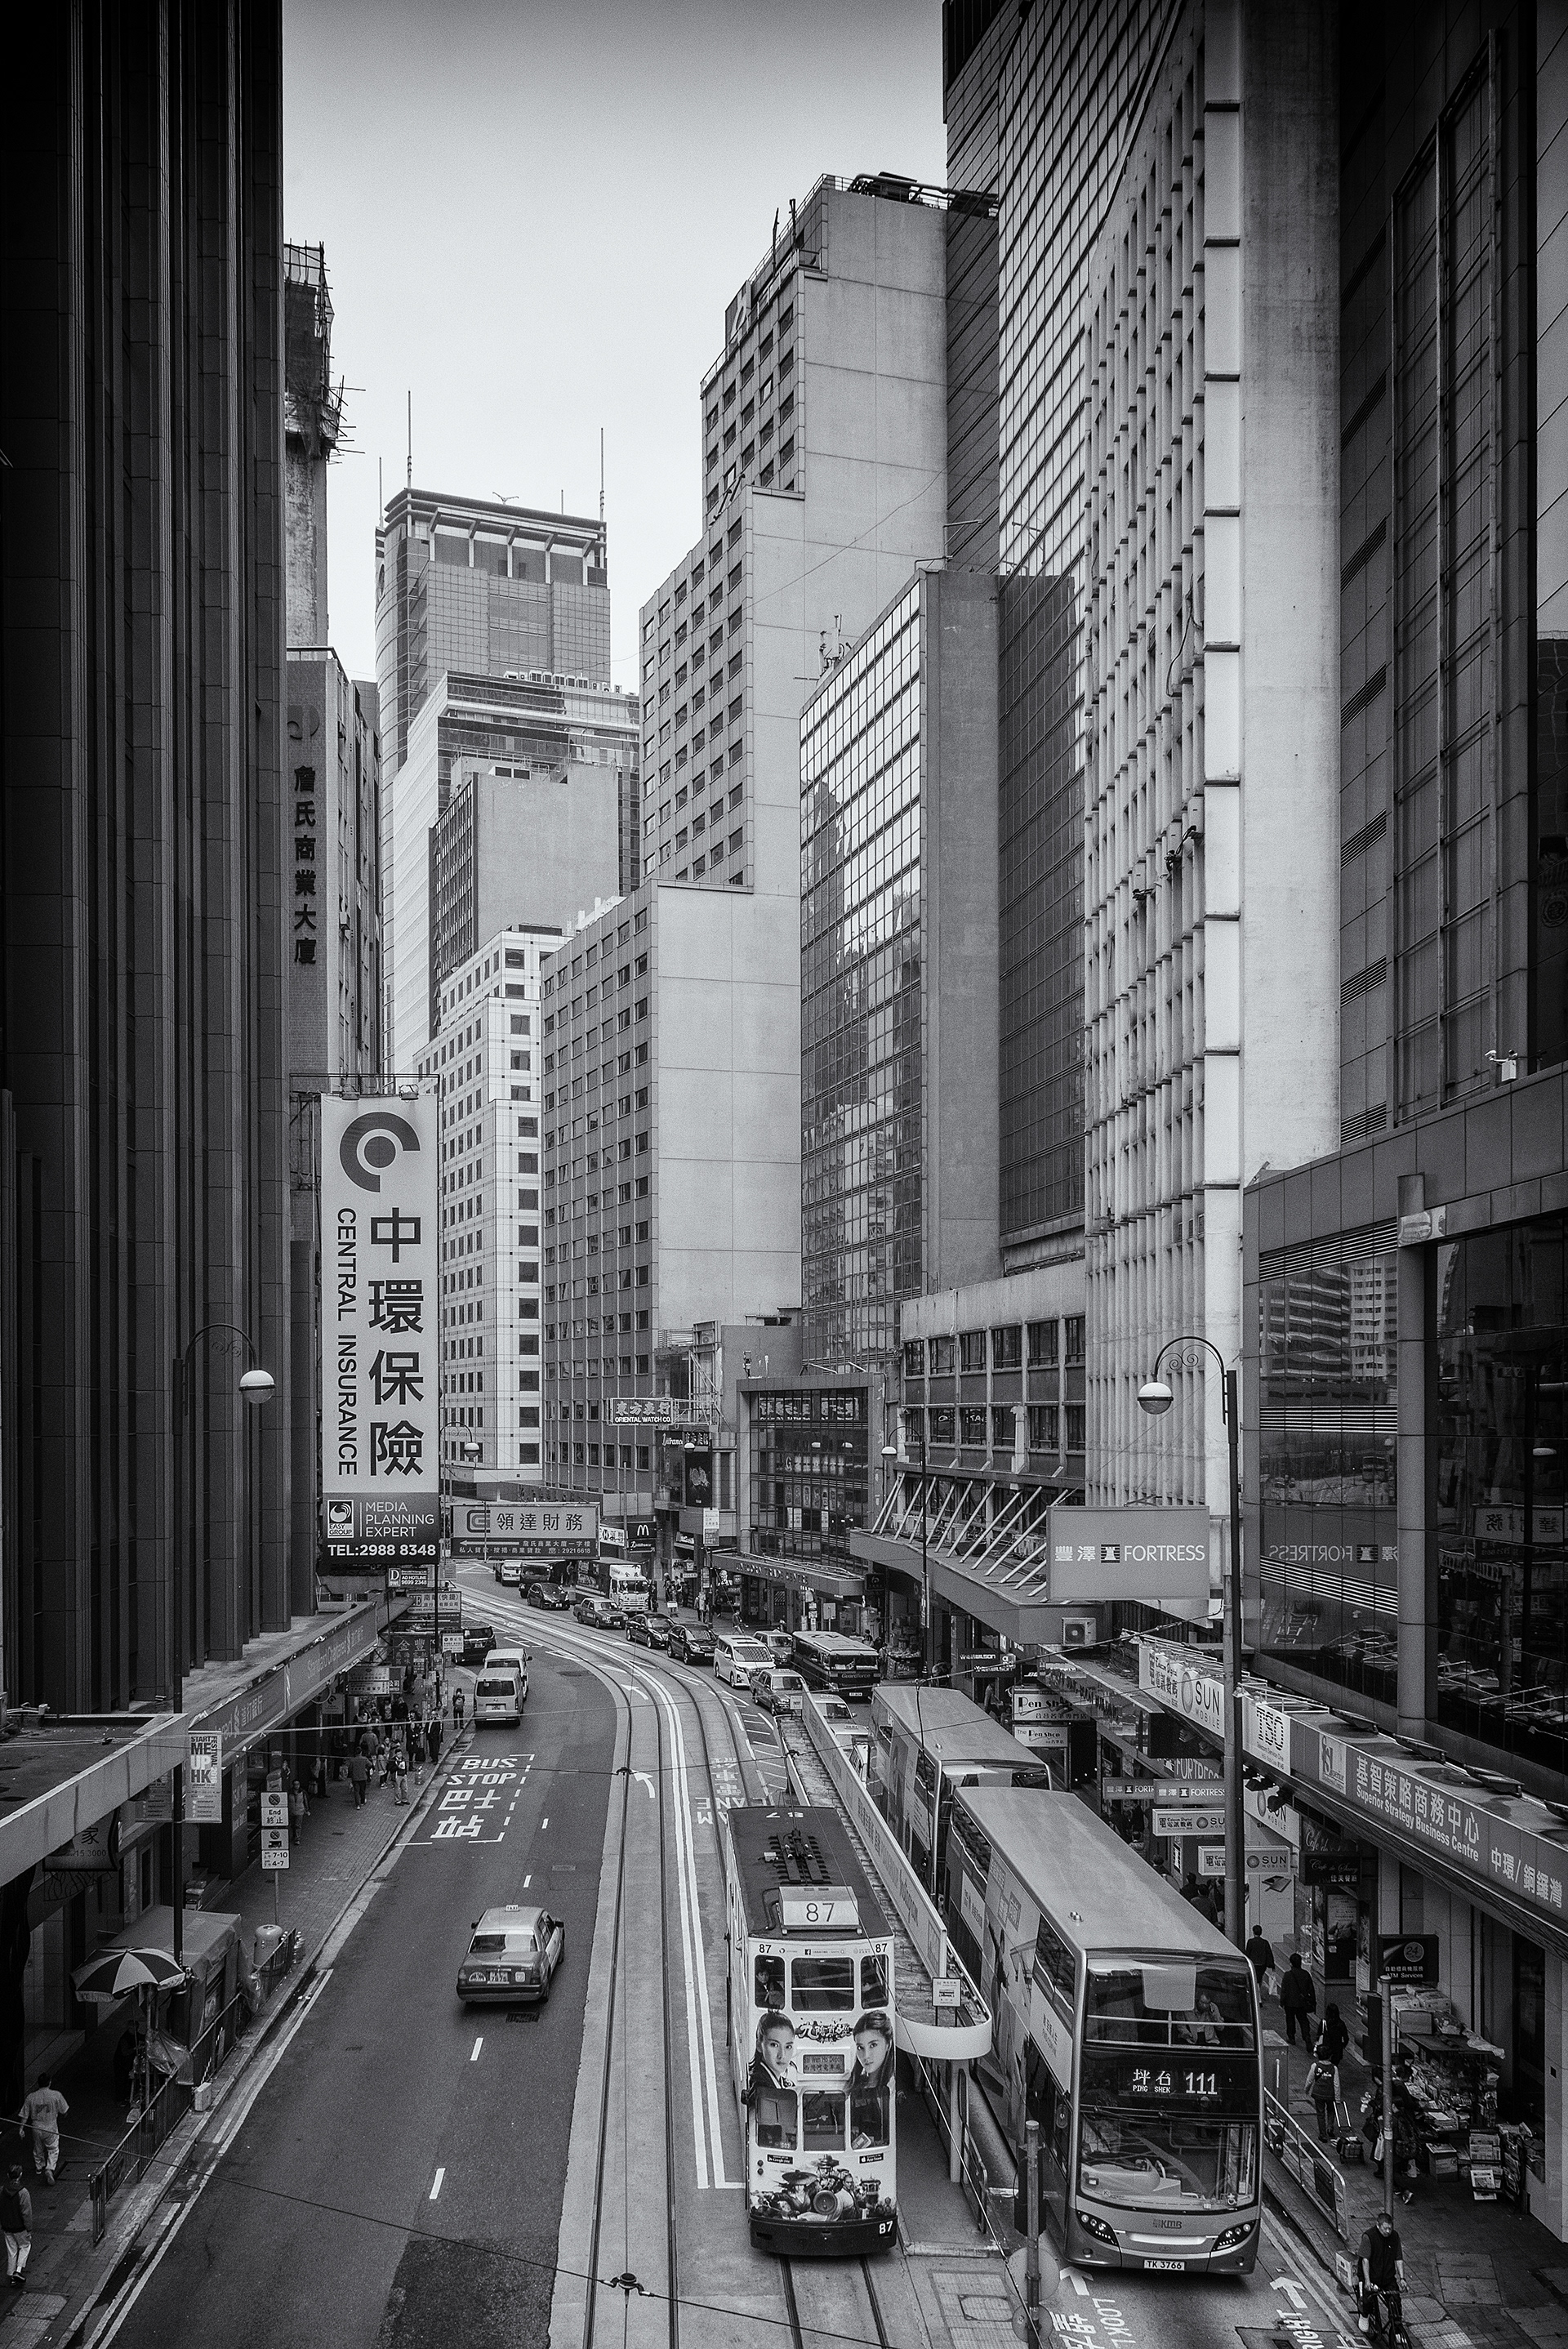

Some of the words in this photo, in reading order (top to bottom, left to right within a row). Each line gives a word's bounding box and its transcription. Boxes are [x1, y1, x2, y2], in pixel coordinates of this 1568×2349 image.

[337, 1207, 357, 1322] CENTRAL
[368, 1207, 424, 1476] 中環保險
[337, 1335, 358, 1476] INSURANCE
[365, 1501, 408, 1512] MEDIA
[365, 1514, 434, 1525] PLANNING
[497, 1513, 583, 1531] 領達財務
[366, 1527, 417, 1537] EXPERT
[327, 1544, 396, 1556] TEL:2988
[399, 1544, 436, 1556] 8348
[1054, 1545, 1096, 1562] 豐澤
[1124, 1544, 1205, 1562] FORTRESS
[1018, 1696, 1042, 1709] Pen
[1195, 1680, 1219, 1716] SUN
[1195, 1707, 1220, 1730] MOBILE
[190, 1742, 212, 1755] ME
[190, 1754, 212, 1770] UP
[461, 1758, 518, 1770] BUS
[190, 1769, 212, 1783] HK
[447, 1772, 517, 1785] STOP
[438, 1789, 501, 1811] 巴士
[1356, 1755, 1480, 1846] 基智策略商務中心
[430, 1814, 485, 1839] 站
[1356, 1784, 1384, 1810] Superior
[1384, 1799, 1414, 1830] Strategy
[1415, 1819, 1450, 1851] Business
[1450, 1839, 1480, 1862] Centre
[81, 1825, 100, 1845] 家
[87, 1849, 107, 1857] 3000
[1262, 1856, 1287, 1864] SUN
[1490, 1847, 1563, 1909] 中環/銅鑼灣
[806, 1902, 835, 1923] 87
[759, 1943, 772, 1954] 87
[875, 1943, 888, 1954] 87
[1405, 1946, 1419, 1955] 24
[1132, 2084, 1149, 2093] PING
[1154, 2085, 1171, 2093] SHEK
[1185, 2071, 1218, 2095] 111
[879, 2220, 893, 2235] 87
[1160, 2219, 1183, 2229] KMB
[1147, 2259, 1159, 2269] TK
[1160, 2260, 1183, 2270] 3766
[1092, 2298, 1132, 2337] LOOK
